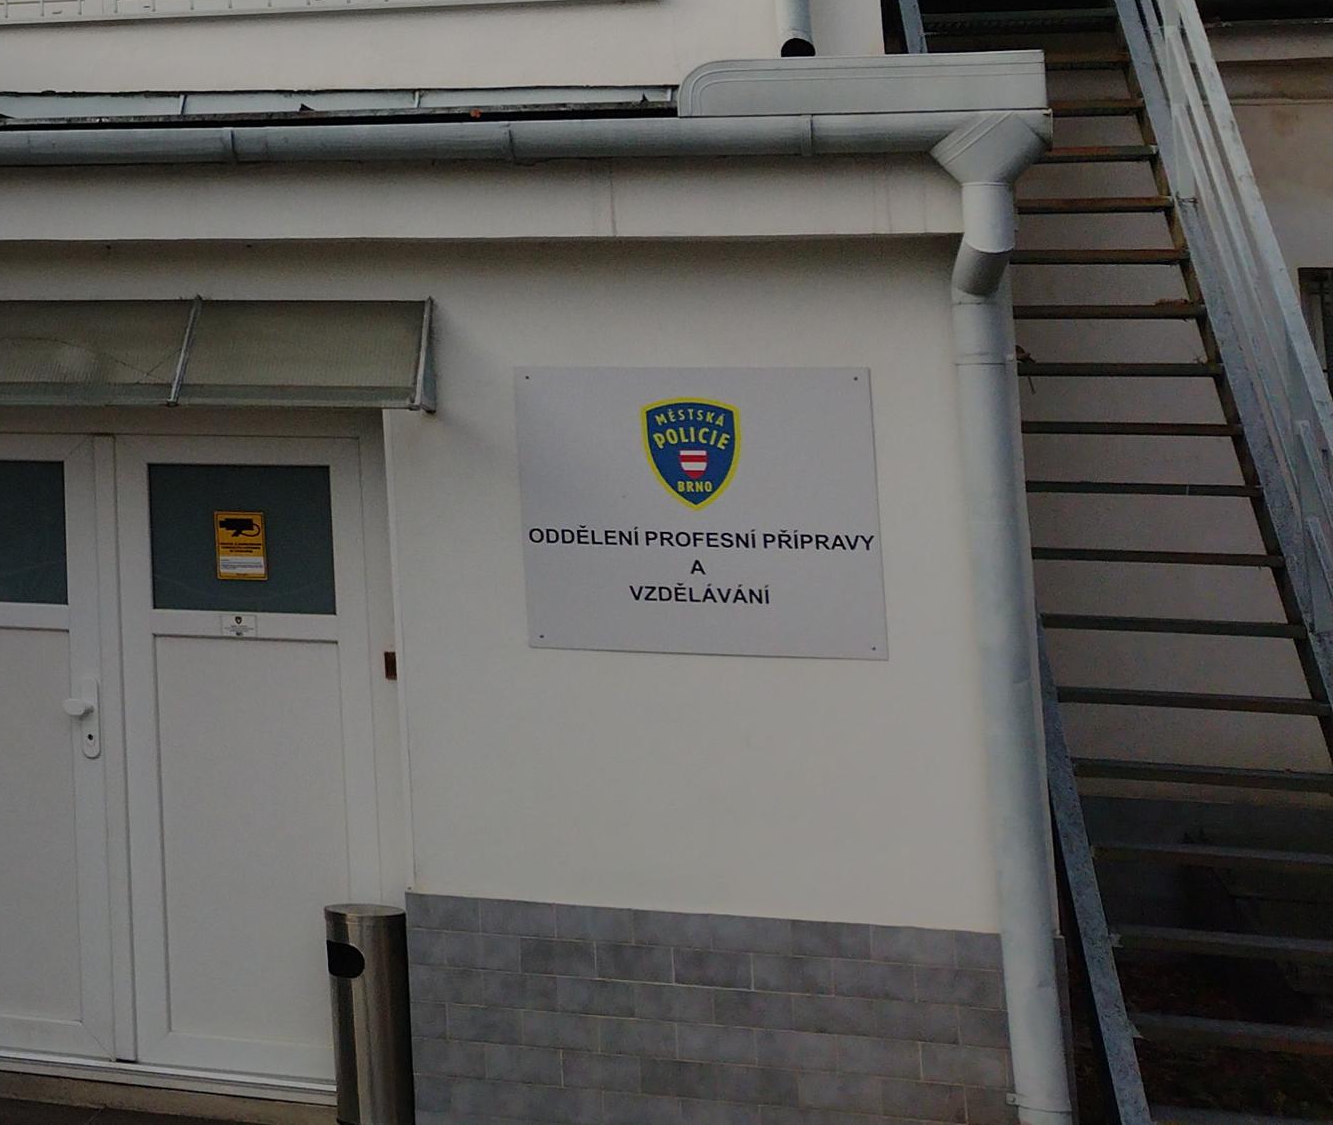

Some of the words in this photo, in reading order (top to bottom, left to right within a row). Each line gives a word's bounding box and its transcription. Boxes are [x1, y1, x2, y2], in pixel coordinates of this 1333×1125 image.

[654, 408, 726, 427] MĚSTSKÁ
[653, 426, 731, 450] POLICIE
[677, 480, 713, 493] BRNO
[528, 525, 640, 547] ODDĚLENÍ
[644, 529, 757, 549] PROFESNÍ
[762, 529, 874, 552] PŘÍPRAVY
[690, 560, 706, 576] A
[629, 583, 771, 605] VZDĚLÁVÁNÍ
